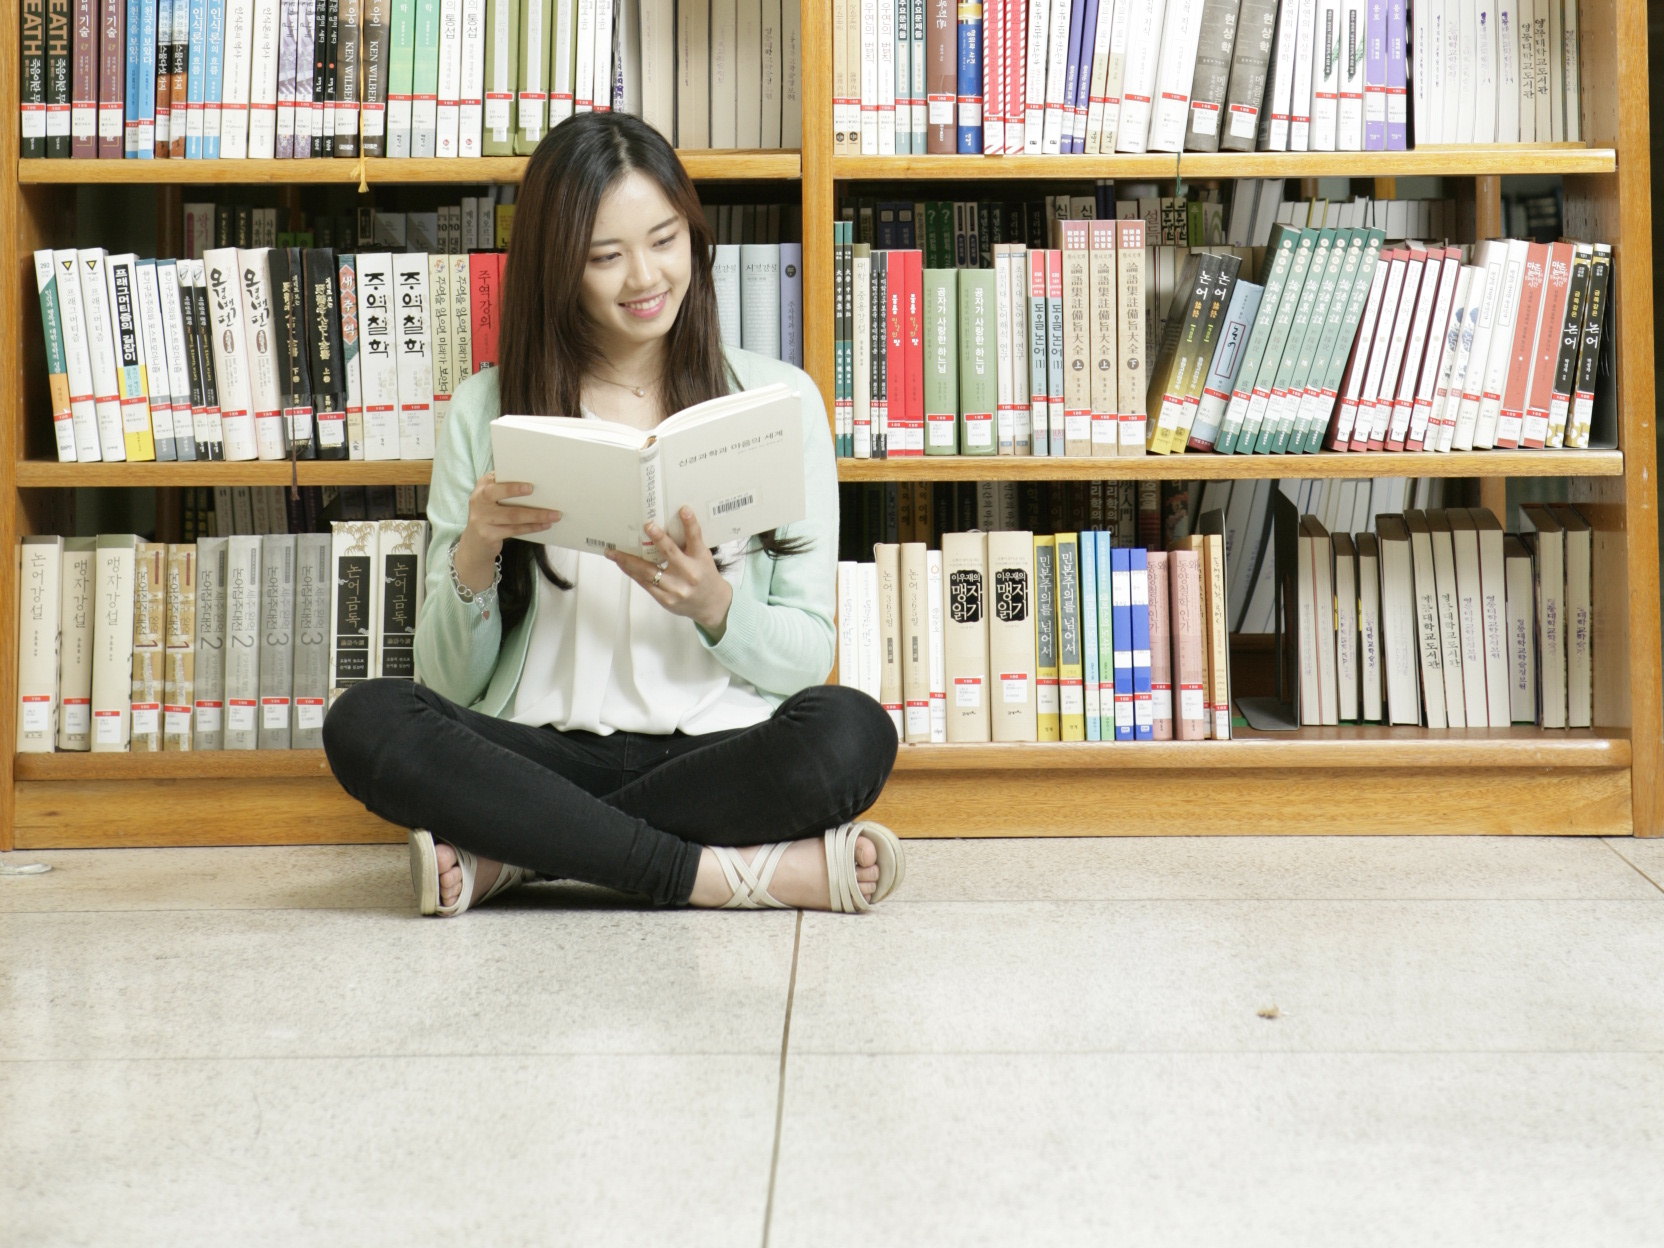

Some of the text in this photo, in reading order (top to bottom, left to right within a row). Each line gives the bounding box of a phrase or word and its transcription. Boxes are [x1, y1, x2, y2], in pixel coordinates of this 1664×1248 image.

[79, 15, 90, 37] 기술
[106, 16, 117, 38] 기술
[130, 7, 139, 34] 천국을
[192, 8, 203, 53] 인식론의
[345, 7, 355, 27] 아이
[445, 14, 456, 39] 통섭
[899, 0, 907, 39] 주요문제들
[936, 0, 947, 30] 목적론
[1372, 4, 1381, 21] 옹호
[129, 37, 138, 64] 보았다
[864, 3, 874, 64] 우연의 법칙
[1221, 13, 1237, 53] 현상학
[1260, 13, 1274, 53] 현상학
[158, 44, 167, 91] 스물다섯 가지
[192, 57, 200, 75] 흐름
[343, 41, 354, 102] KEN WILBER
[478, 270, 491, 329] 주역강의
[1196, 271, 1212, 300] 논어
[1215, 272, 1231, 301] 논어
[116, 268, 136, 362] 프래그머티즘의 길잡이
[364, 272, 390, 359] 주역철학
[400, 271, 425, 357] 주역철학
[937, 287, 947, 374] 공자가 사랑한 하느님
[975, 287, 985, 375] 공자가 사랑한 하느님
[1034, 304, 1044, 356] 도올논어
[1073, 360, 1083, 370] 上
[1129, 359, 1138, 369] 下
[678, 429, 784, 467] 신경과학과 마음의 세계
[30, 553, 46, 620] 논어강설
[74, 560, 89, 629] 맹자강설
[106, 557, 122, 626] 맹자강설
[345, 564, 362, 628] 논어금독
[392, 562, 409, 627] 논어금독
[951, 573, 981, 582] 이우재의
[952, 582, 983, 601] 맹자
[996, 572, 1026, 581] 이우재의
[997, 581, 1028, 601] 맹자
[136, 572, 148, 636] 논어집주대전
[167, 574, 179, 636] 논어집주대전
[201, 570, 212, 633] 논어집주대전
[952, 602, 983, 621] 읽기
[998, 601, 1027, 620] 읽기
[1039, 555, 1053, 658] 민본주의를 넘어서
[1061, 552, 1076, 655] 민본주의를 넘어서
[1179, 560, 1191, 633] 동양철학인가
[201, 637, 223, 650] 2
[267, 633, 289, 646] 3
[301, 632, 323, 646] 3
